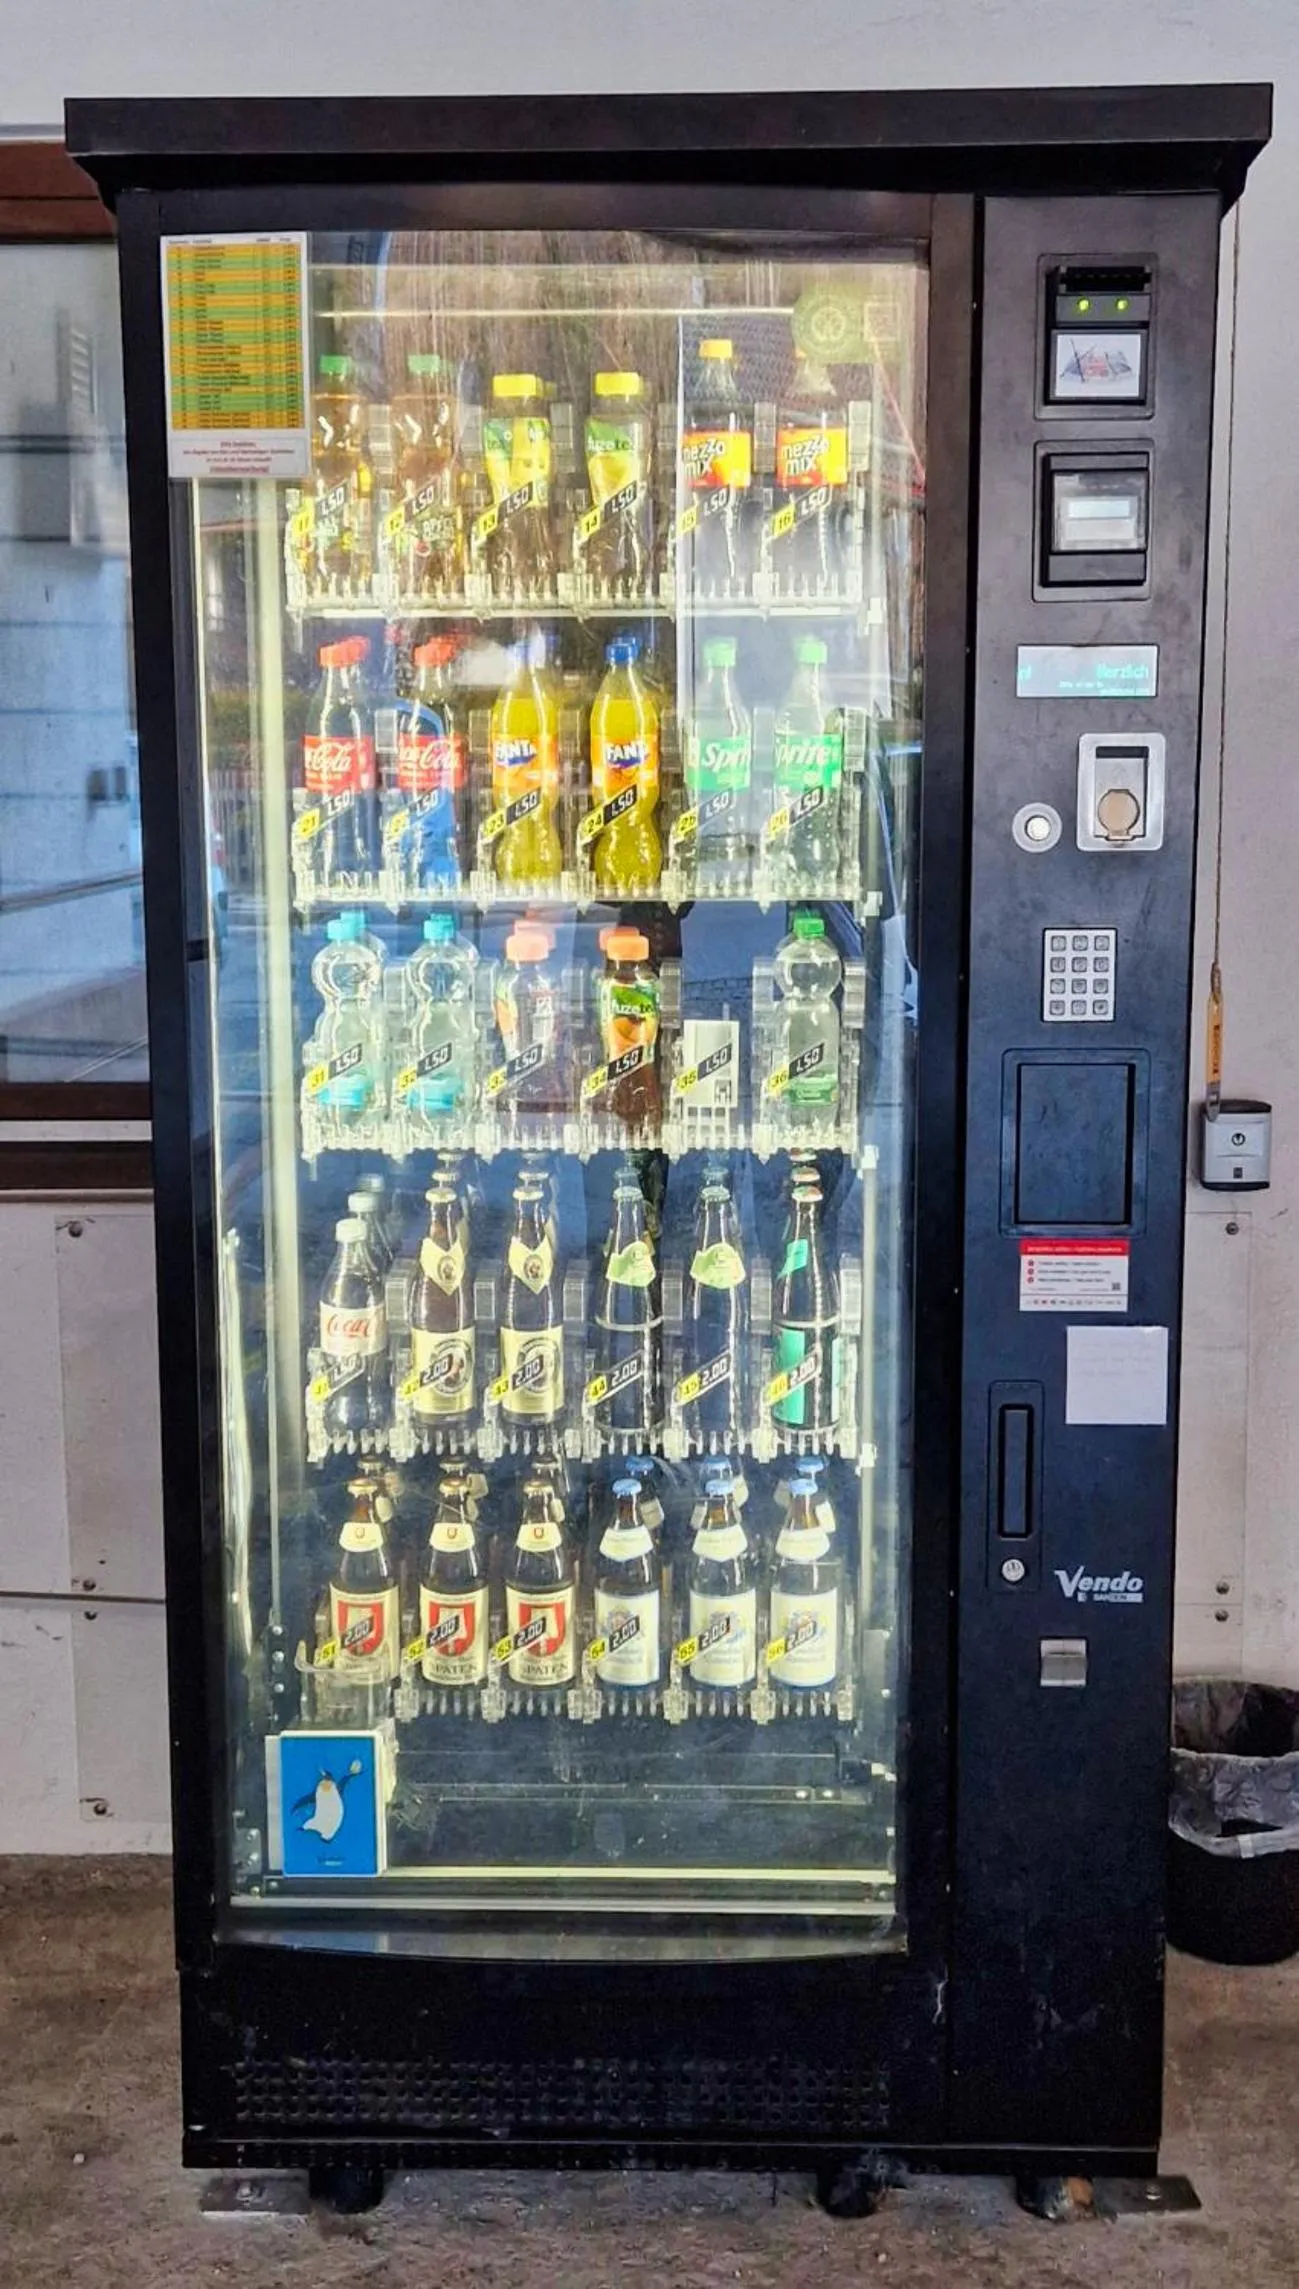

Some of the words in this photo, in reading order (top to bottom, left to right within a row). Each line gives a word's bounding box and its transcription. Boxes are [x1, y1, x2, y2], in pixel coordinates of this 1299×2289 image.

[421, 1358, 449, 1384] 2.00
[514, 1357, 541, 1386] 2.00
[611, 1359, 638, 1386] 2.00
[701, 1356, 729, 1386] 2.00
[789, 1356, 816, 1385] 2.00
[1054, 1565, 1143, 1598] Vendo
[344, 1619, 371, 1647] 2.00
[429, 1618, 456, 1645] 2.00
[517, 1619, 545, 1644] 2.00
[612, 1619, 638, 1647] 2.00
[700, 1620, 728, 1648] 2.00
[787, 1621, 816, 1649] 2.00
